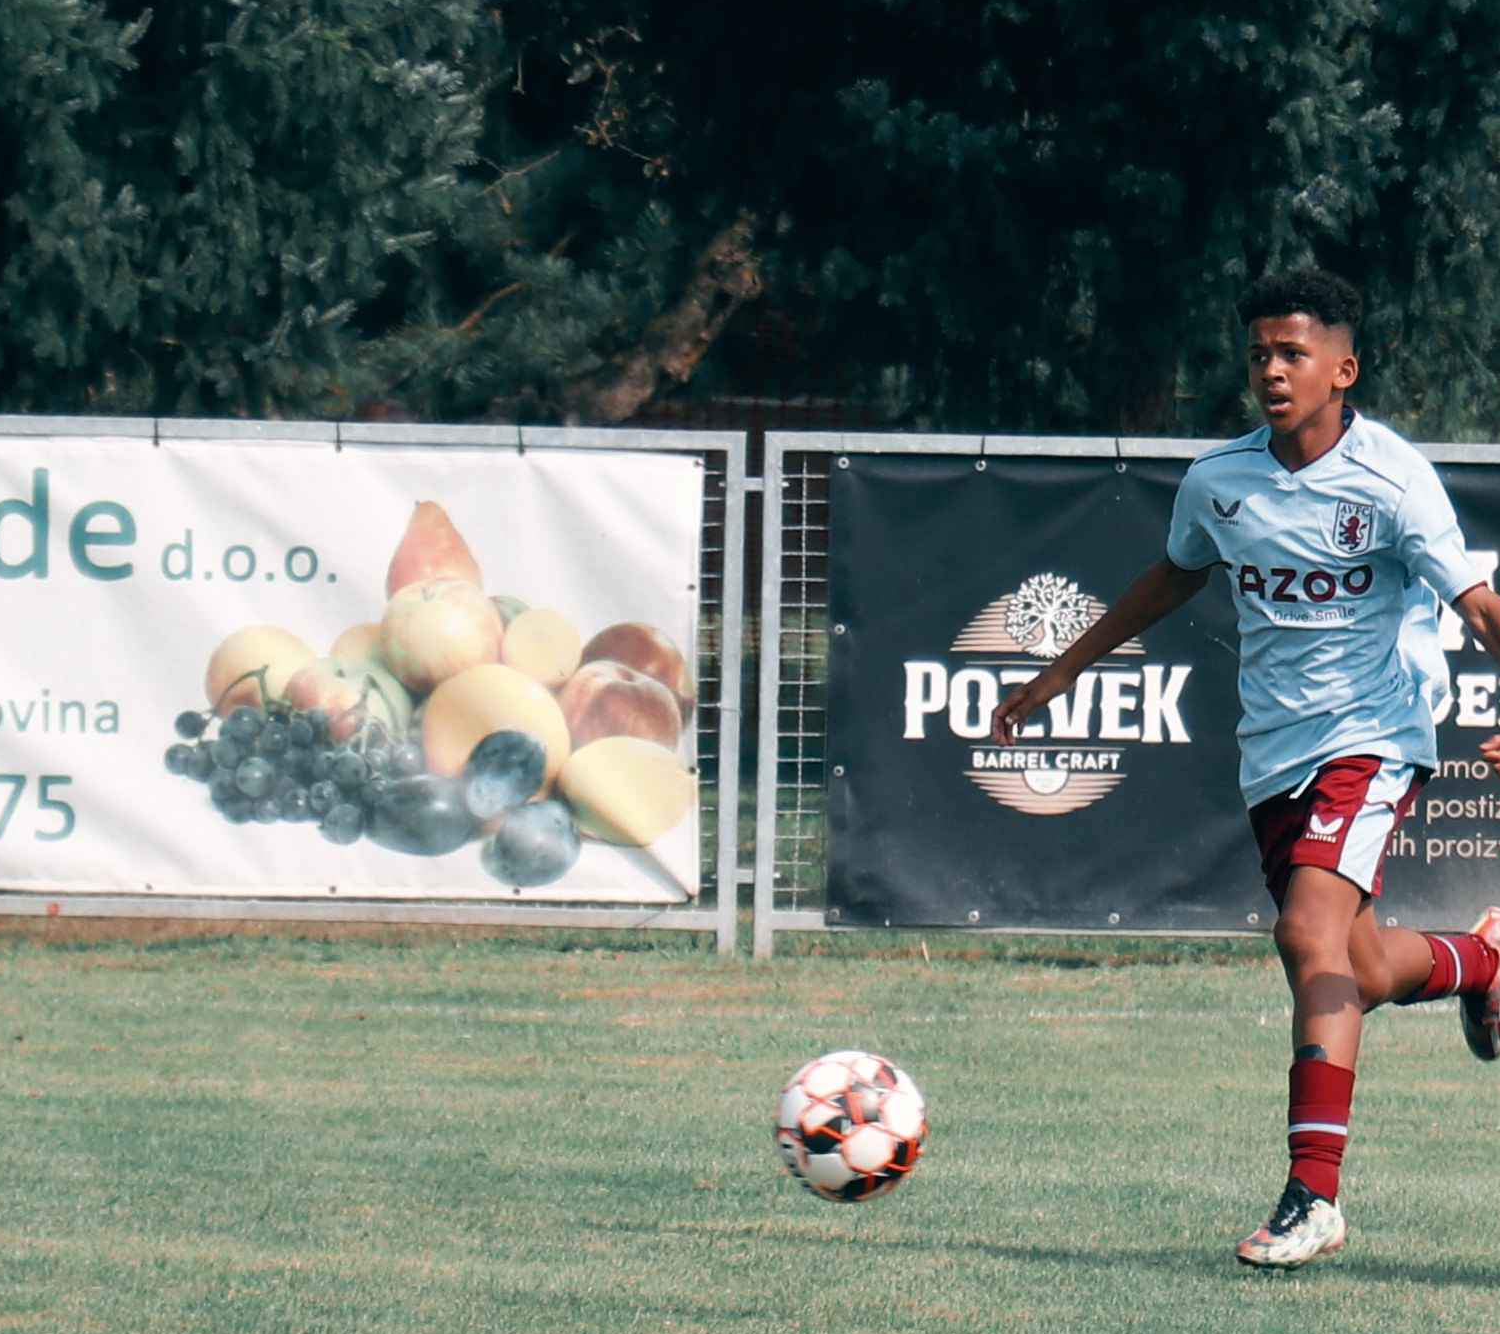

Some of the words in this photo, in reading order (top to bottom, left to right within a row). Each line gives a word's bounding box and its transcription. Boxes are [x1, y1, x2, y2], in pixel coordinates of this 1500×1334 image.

[161, 529, 338, 583] d.o.o.
[972, 751, 1050, 770] BARREL
[1055, 753, 1120, 772] CRAFT
